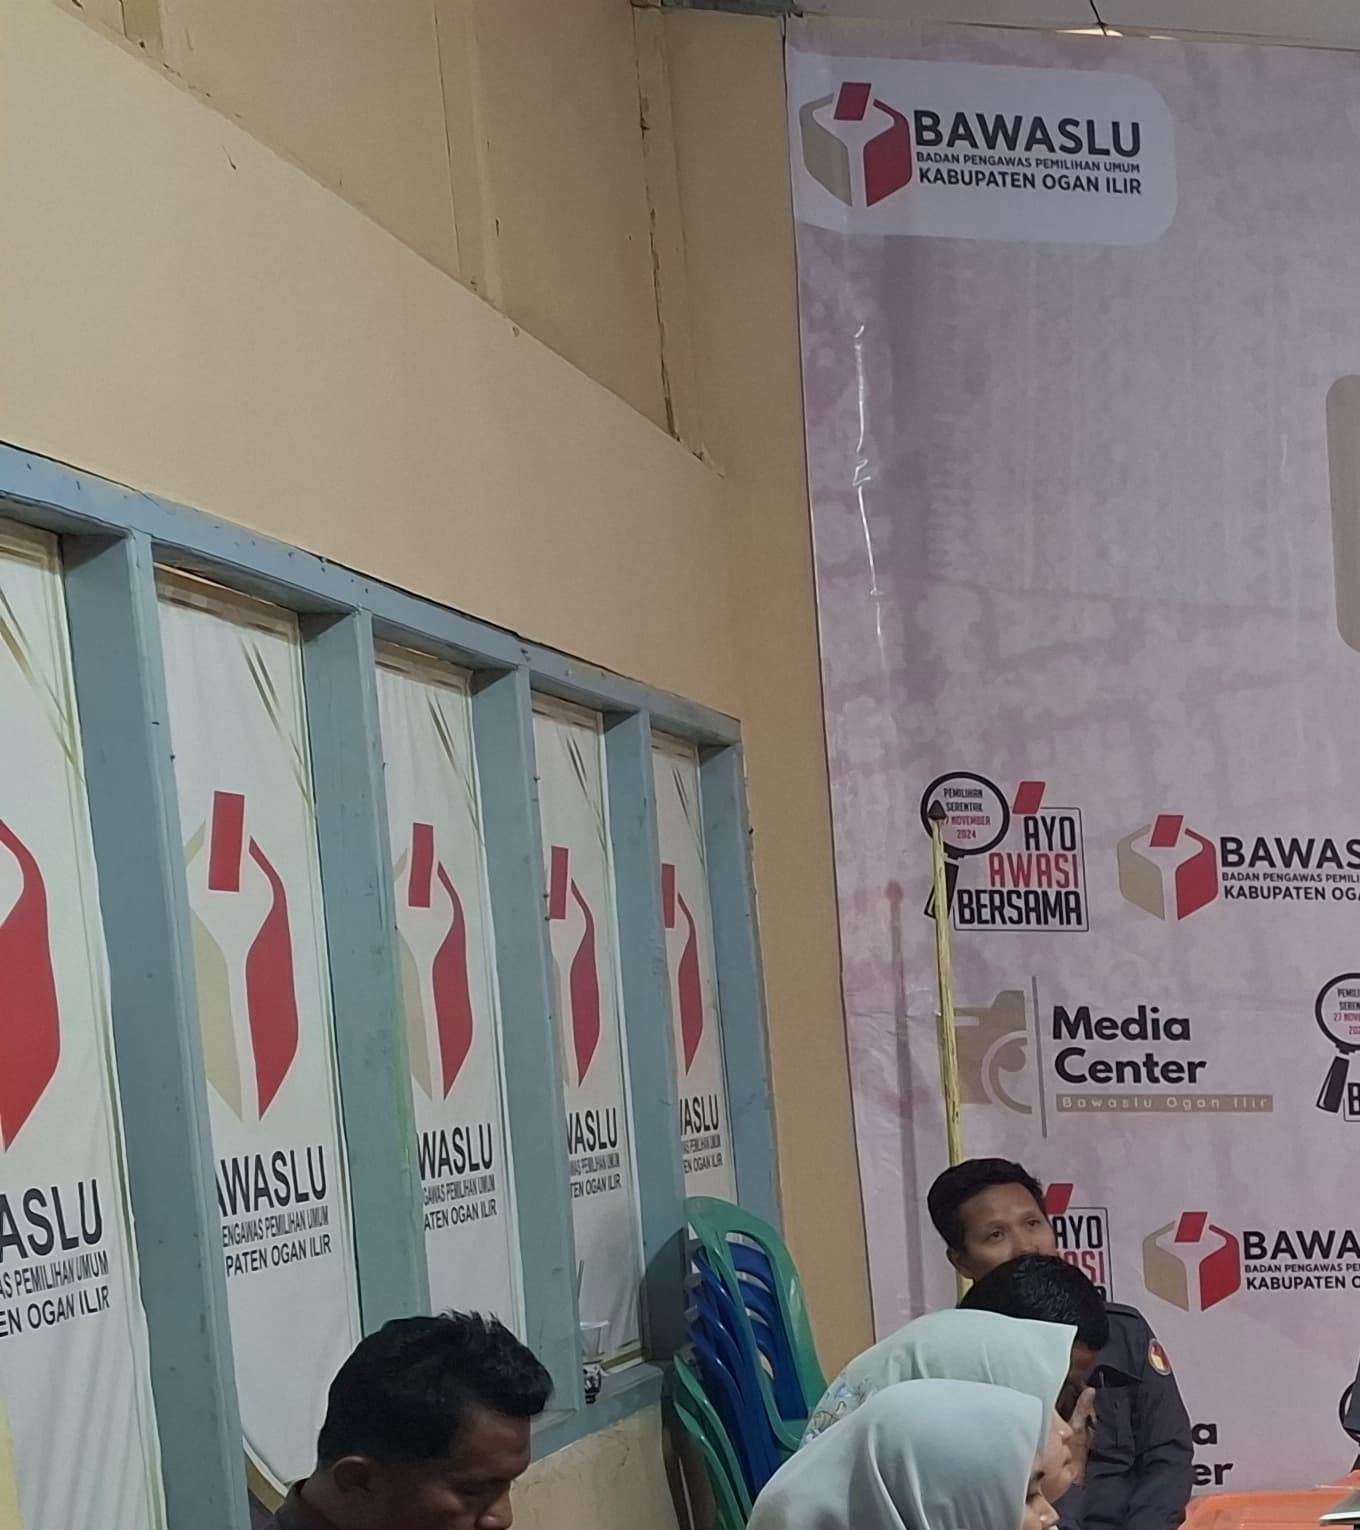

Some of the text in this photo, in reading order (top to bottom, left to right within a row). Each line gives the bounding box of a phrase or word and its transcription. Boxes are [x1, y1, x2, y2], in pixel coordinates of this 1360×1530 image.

[913, 109, 1141, 158] BAWASLU
[916, 151, 1141, 174] BADAN PENGAWAS PEMILIHAN UMUM
[918, 168, 1142, 195] KABUPATEN OGAN ILIR
[956, 829, 977, 839] 2024
[1024, 816, 1076, 851] AYO
[988, 853, 1079, 889] AWASI
[1221, 872, 1260, 882] BADAN
[1262, 872, 1322, 883] PENGAWAS
[957, 889, 1083, 925] BERSAMA
[1224, 885, 1326, 901] KABUPATEN
[1052, 1005, 1191, 1041] Media
[1054, 1047, 1207, 1084] Center
[680, 1094, 720, 1136] ASLU
[1062, 1096, 1152, 1109] Bawaslu
[1166, 1096, 1220, 1111] Ogan
[566, 1107, 619, 1155] ASLU
[415, 1122, 494, 1181] WASLU
[216, 1145, 327, 1218] WASLU
[0, 1178, 103, 1260] ASLU
[222, 1218, 264, 1248] ENGAWAS
[265, 1211, 306, 1239] PEMILIHAN
[450, 1205, 480, 1226] OGAN
[1054, 1215, 1102, 1250] AYO
[225, 1233, 333, 1278] PATEN OGAN ILIR
[1244, 1264, 1281, 1273] BADAN
[1284, 1263, 1343, 1273] PENGAWAS
[16, 1255, 76, 1298] PEMILIHAN
[76, 1250, 110, 1283] UMUM
[1246, 1275, 1346, 1291] KABUPATEN
[27, 1298, 75, 1330] OGAN
[79, 1285, 111, 1317] ILIR
